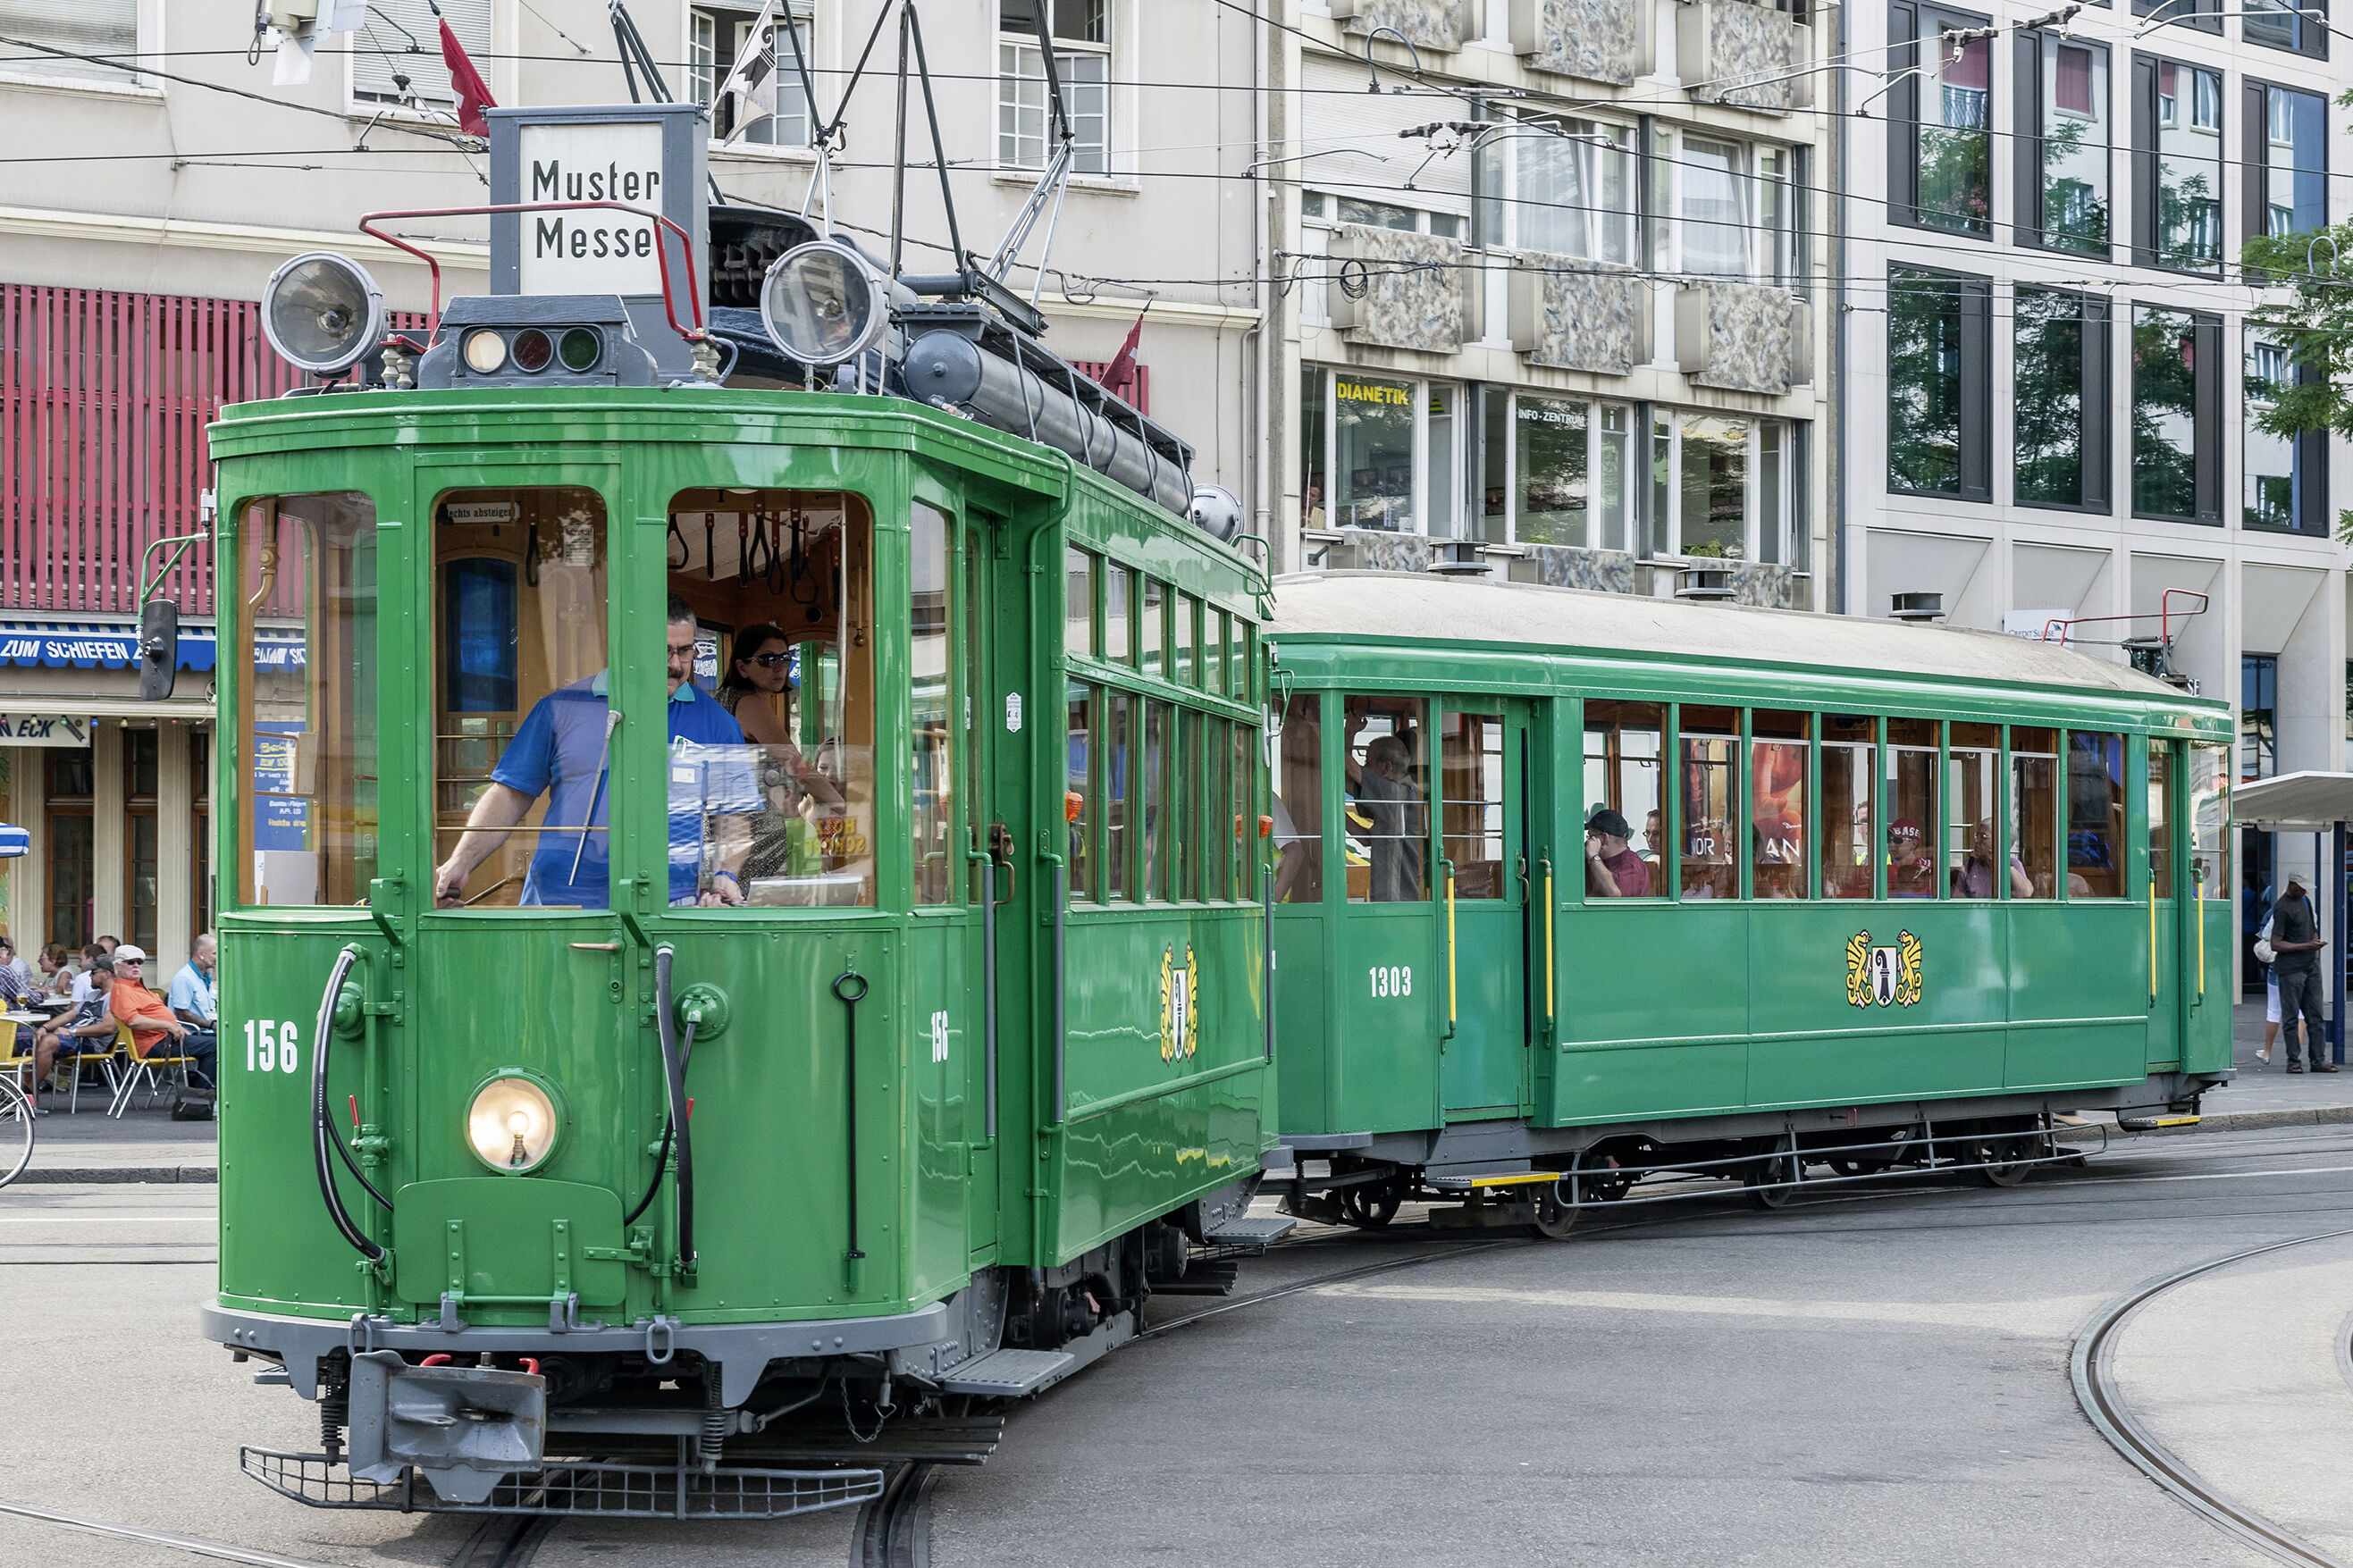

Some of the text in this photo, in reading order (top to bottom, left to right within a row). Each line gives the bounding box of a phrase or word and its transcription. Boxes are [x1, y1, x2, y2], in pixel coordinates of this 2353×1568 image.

[533, 159, 660, 201] Muster
[536, 217, 651, 258] Messe
[1337, 382, 1408, 406] DIANETIK
[1, 639, 41, 658] ZUM
[45, 641, 130, 660] SCHIEFEN
[16, 719, 55, 738] ECK
[1369, 966, 1412, 998] 1303
[244, 1019, 298, 1074] 156
[931, 1010, 948, 1063] 156
